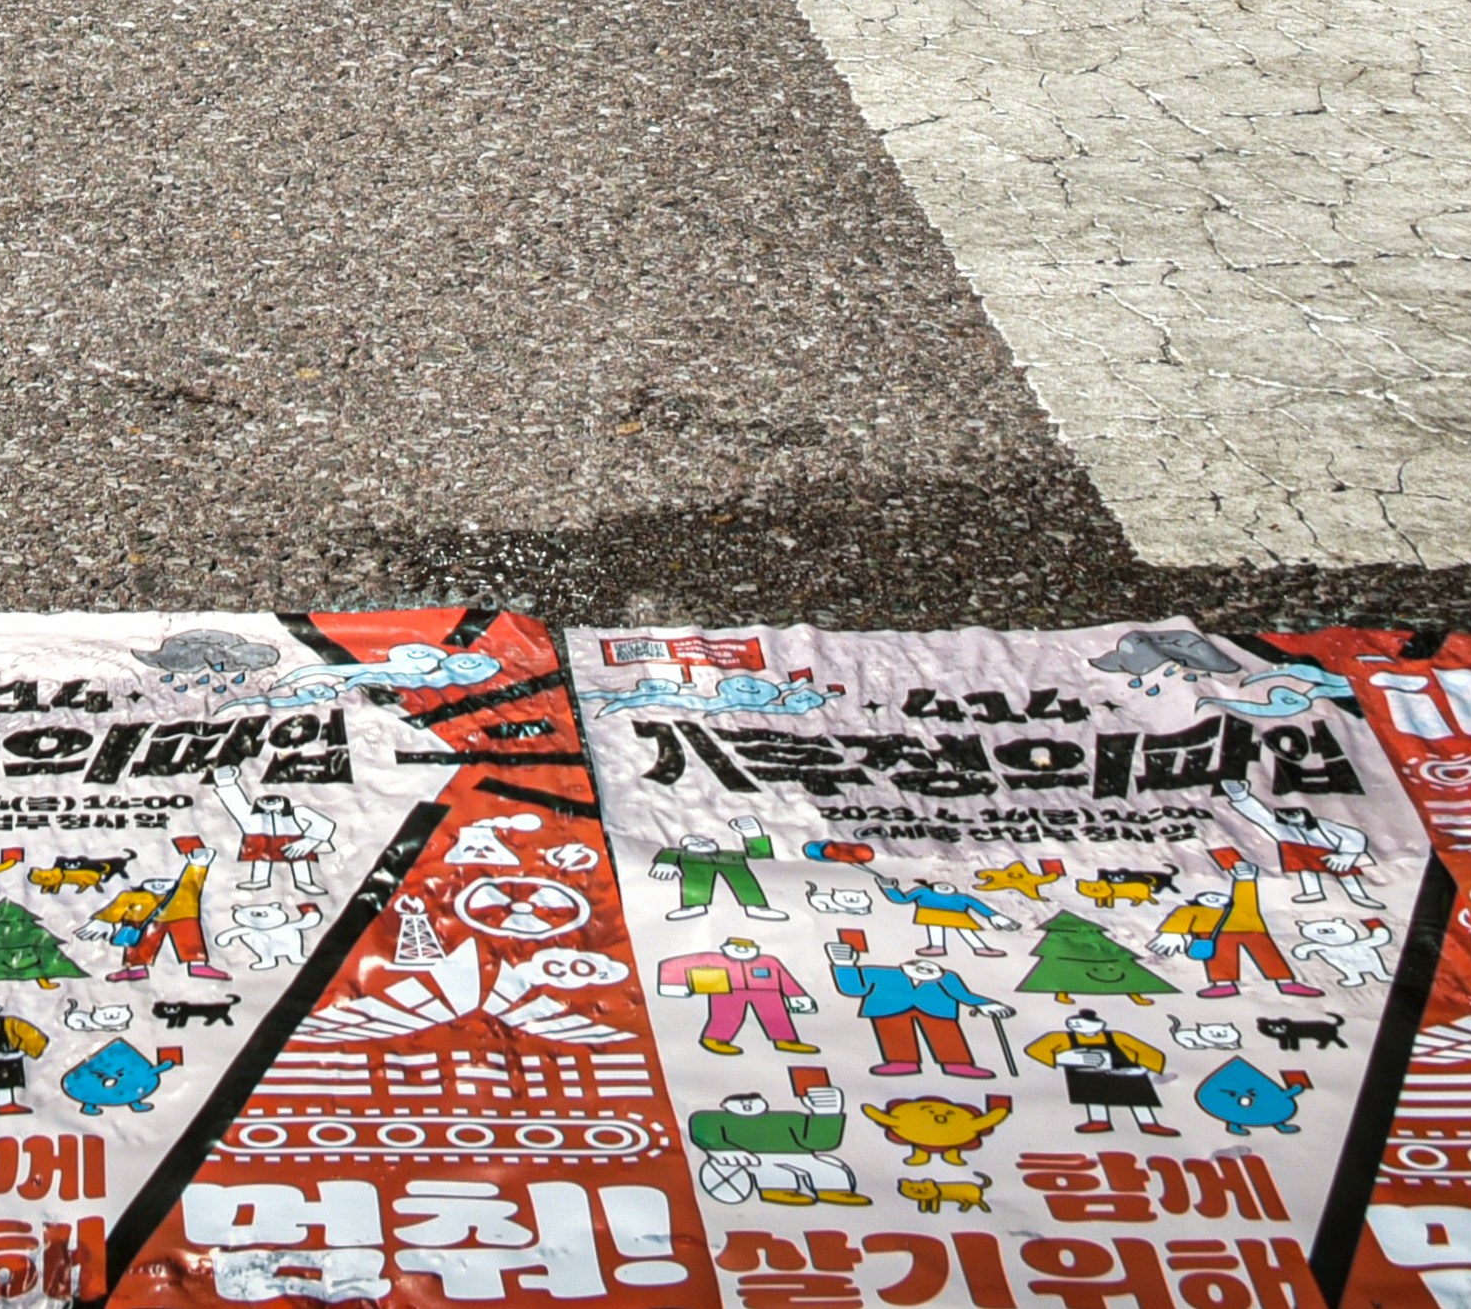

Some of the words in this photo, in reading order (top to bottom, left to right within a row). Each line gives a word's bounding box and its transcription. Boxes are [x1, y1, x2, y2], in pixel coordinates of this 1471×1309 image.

[902, 687, 1093, 725] 414
[83, 794, 194, 811] 14:00
[542, 958, 609, 981] CO2
[1015, 1151, 1291, 1222] 함께
[180, 1179, 689, 1303] 멈춰!
